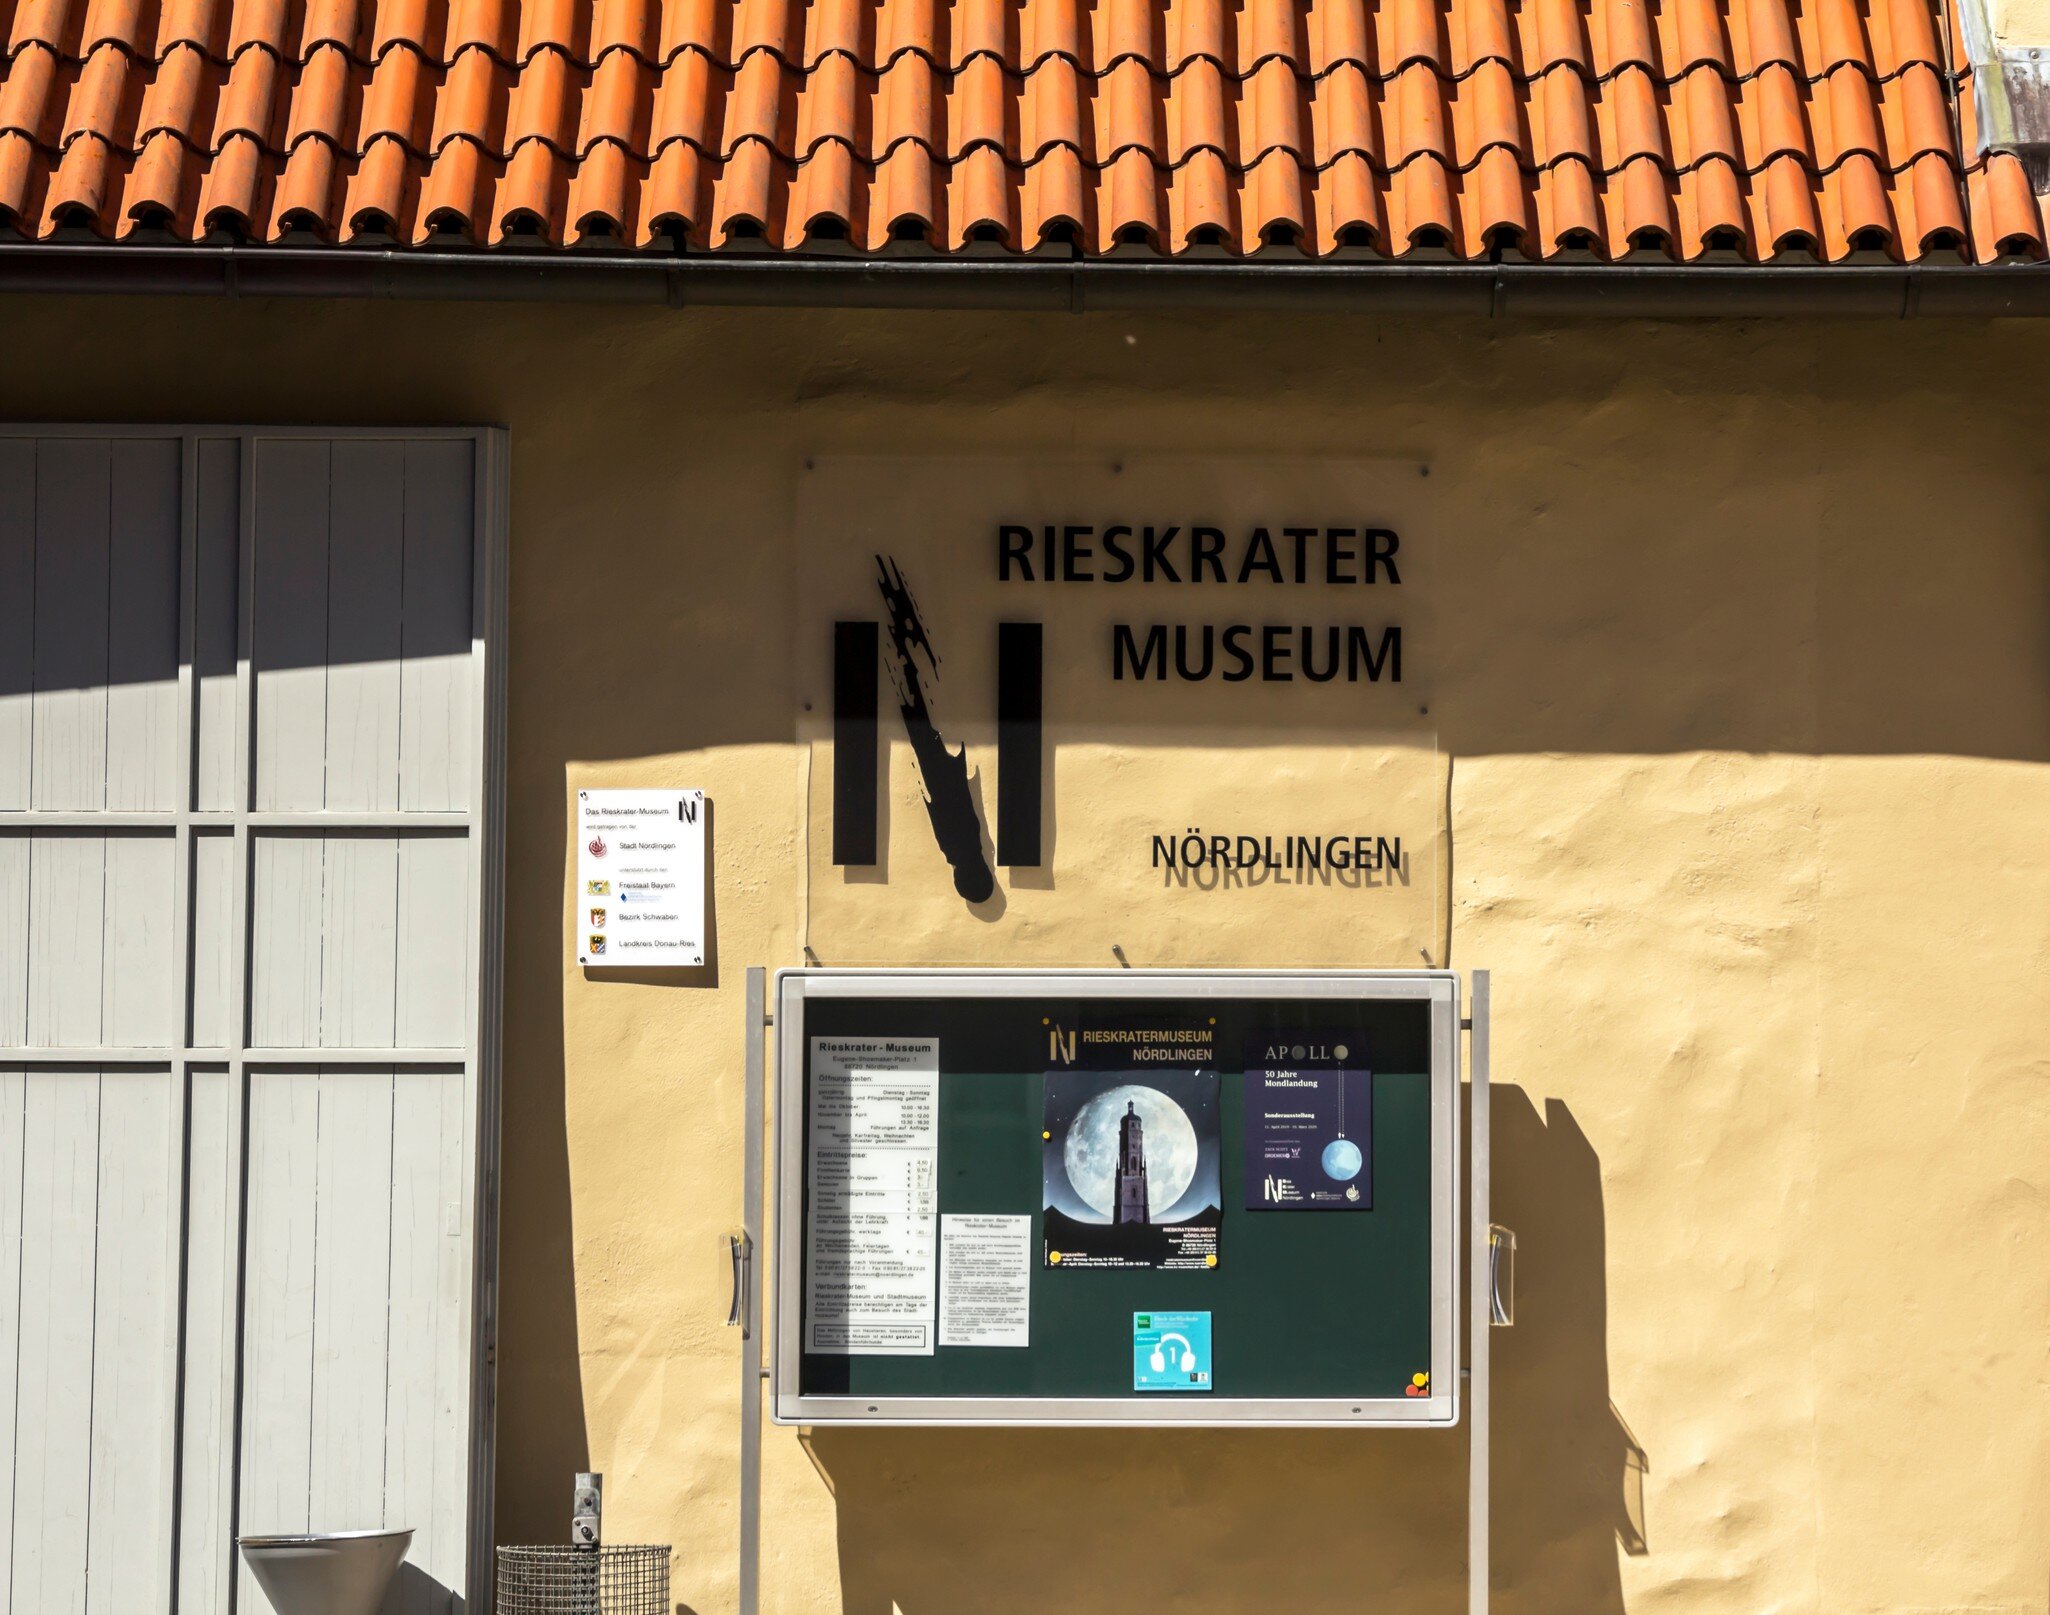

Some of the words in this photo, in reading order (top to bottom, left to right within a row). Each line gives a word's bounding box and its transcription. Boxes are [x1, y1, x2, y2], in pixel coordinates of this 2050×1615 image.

[998, 524, 1402, 585] RIESKRATER
[1113, 624, 1402, 683] MUSEUM
[1151, 828, 1401, 870] NÖRDLINGEN
[651, 882, 675, 890] Bayern
[1083, 1031, 1212, 1042] RIESKRATERMUSEUM
[819, 1043, 877, 1052] Rieskrater
[886, 1044, 931, 1052] Museum
[1133, 1047, 1212, 1061] NÖRDLINGEN
[1265, 1070, 1275, 1078] 50
[1276, 1070, 1298, 1079] Jahre
[1265, 1080, 1318, 1088] Mondlandung
